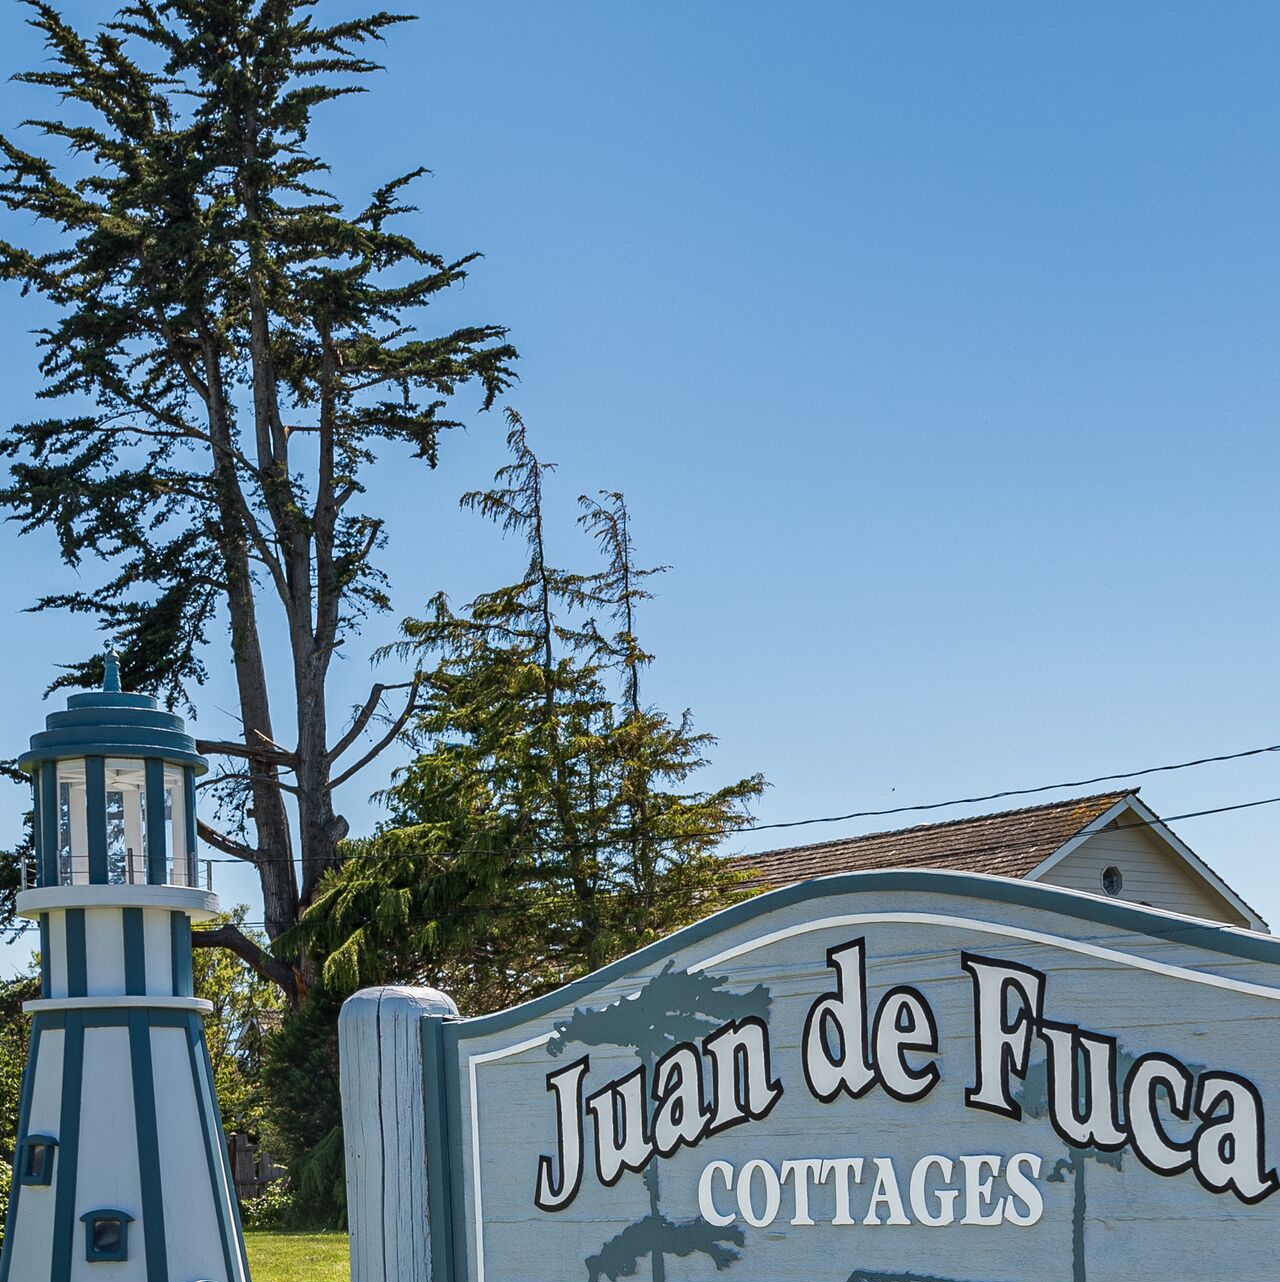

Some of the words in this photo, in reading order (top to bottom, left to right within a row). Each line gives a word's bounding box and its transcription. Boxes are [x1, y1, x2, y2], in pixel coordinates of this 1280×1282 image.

[534, 1016, 784, 1212] Juan
[802, 937, 941, 1104] de
[961, 951, 1280, 1205] Fuca
[697, 1153, 1044, 1228] COTTAGES
